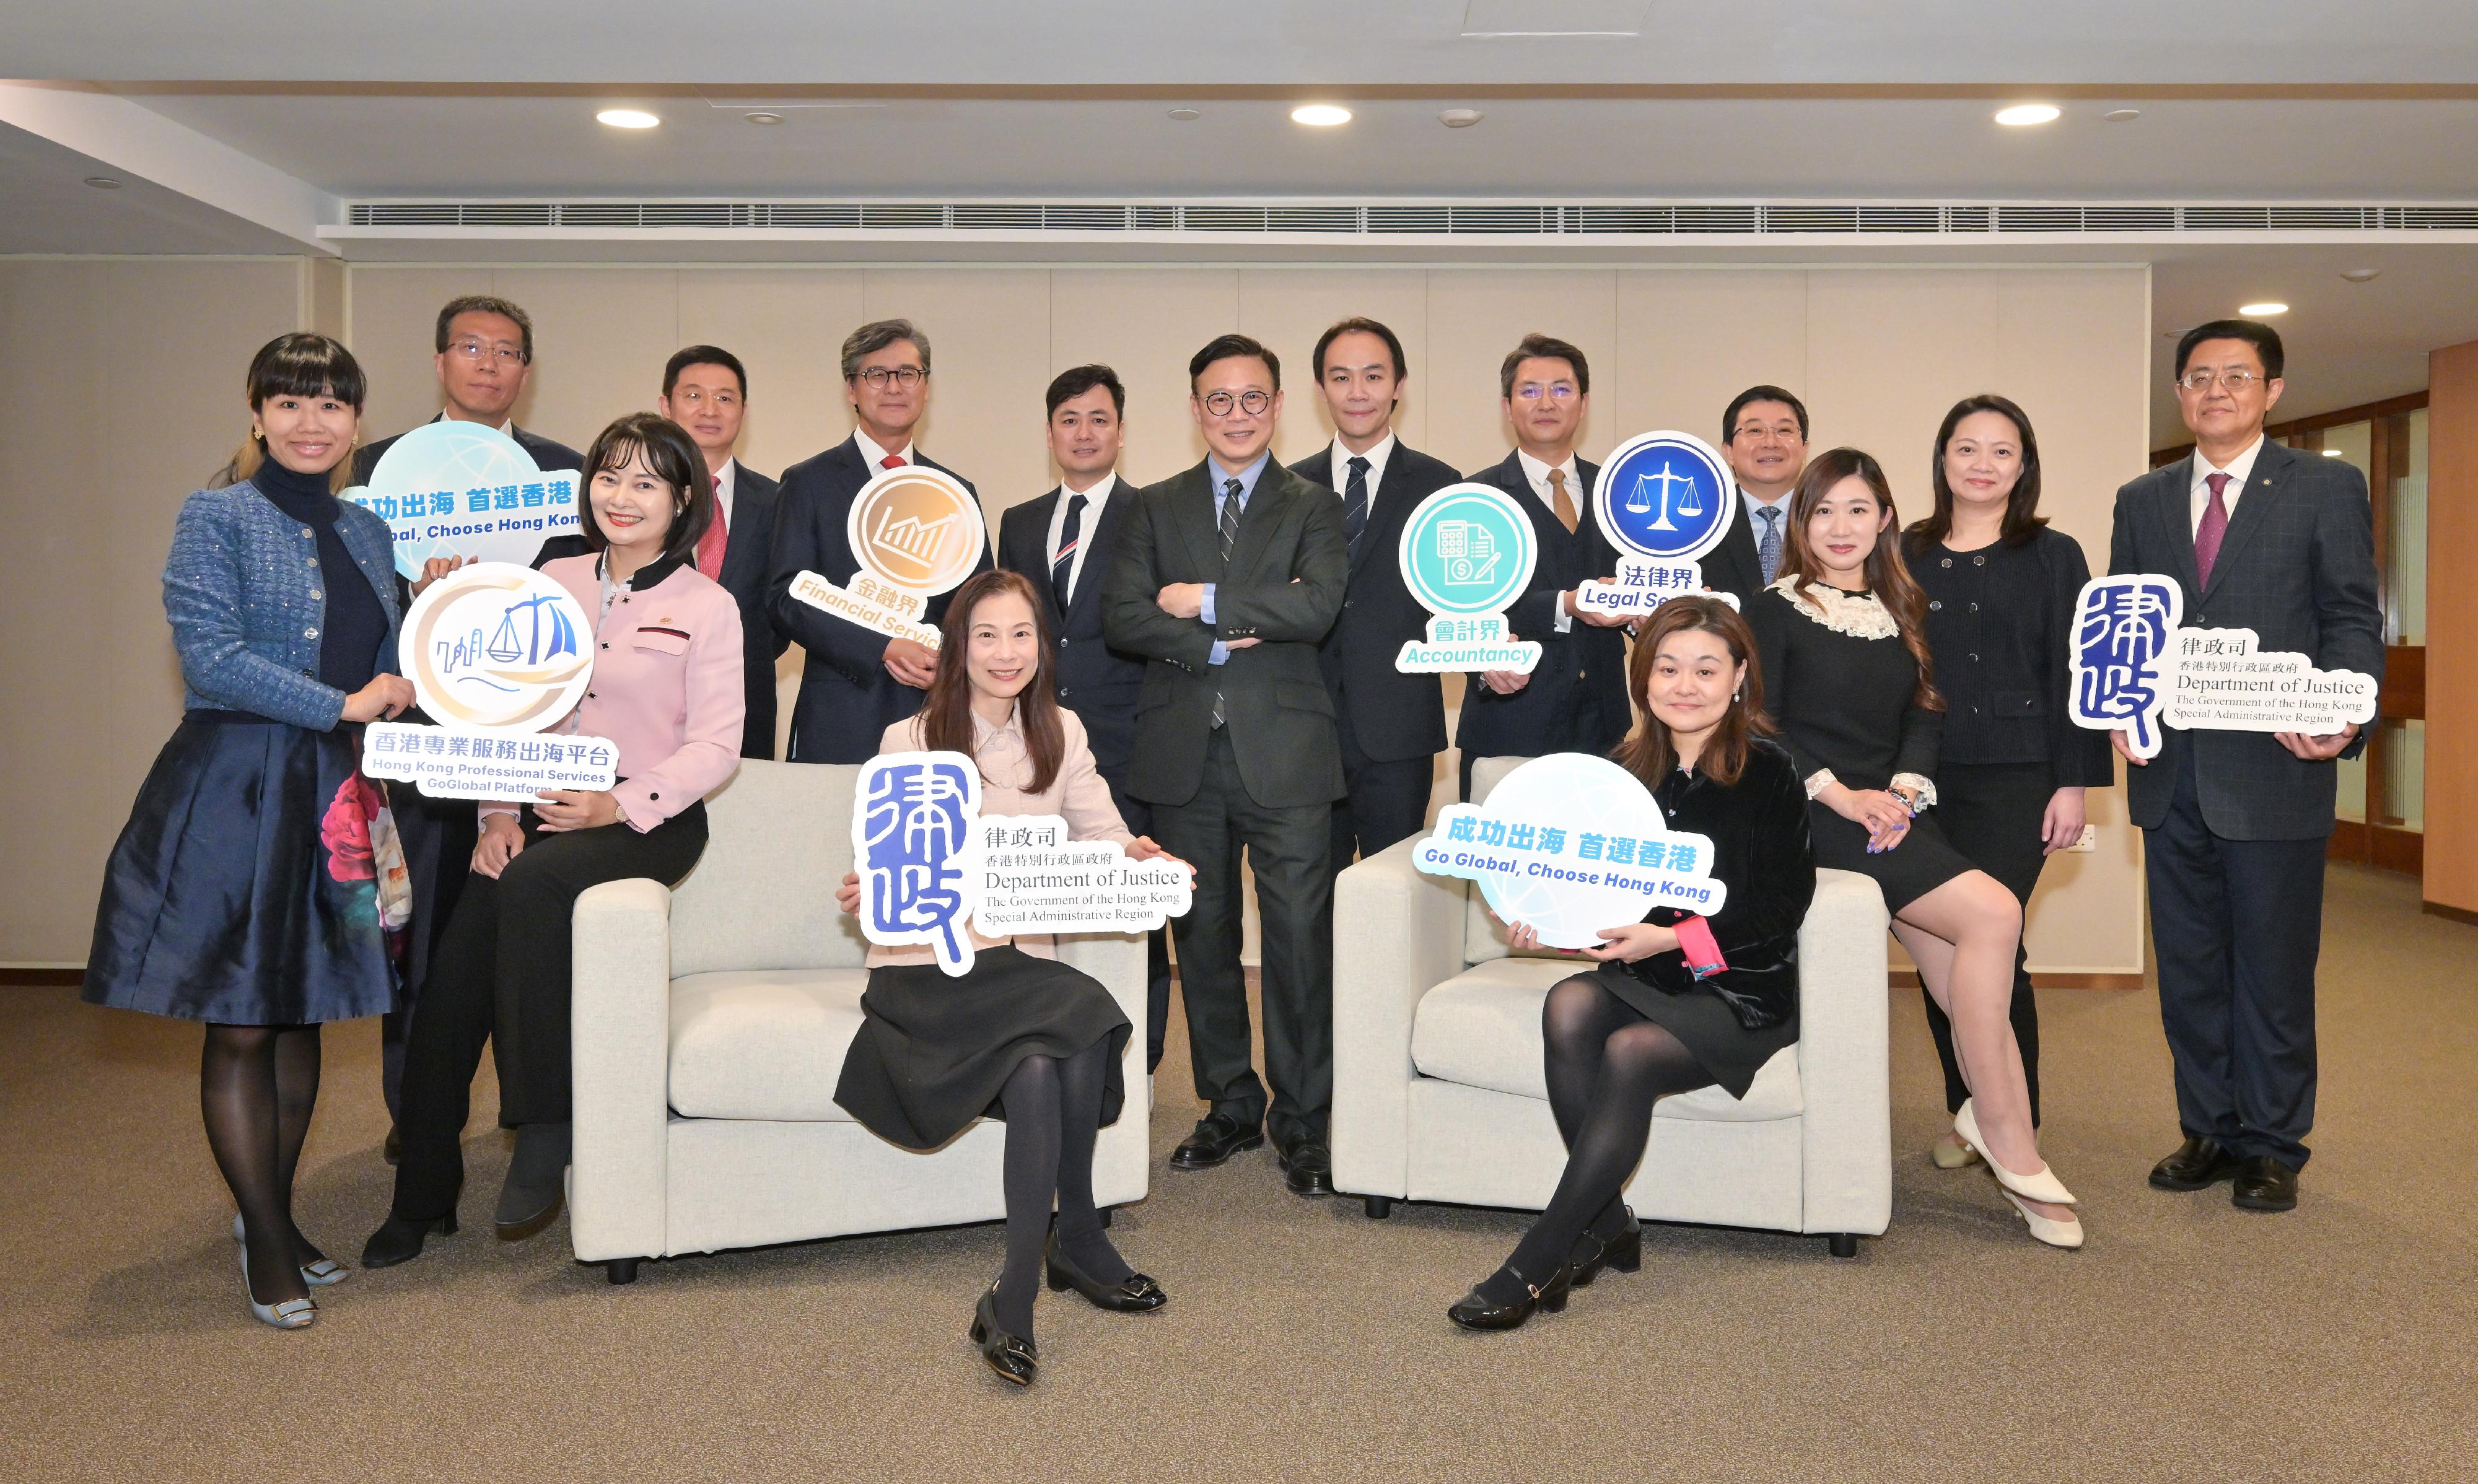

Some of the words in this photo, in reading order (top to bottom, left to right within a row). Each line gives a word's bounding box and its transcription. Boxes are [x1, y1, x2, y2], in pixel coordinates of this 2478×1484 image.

[355, 491, 454, 520] 功出海
[466, 481, 572, 512] 首選香港
[427, 523, 493, 538] Choose
[498, 517, 543, 531] Hong
[548, 514, 580, 526] Kon
[1624, 565, 1692, 589] 法律界
[854, 578, 918, 616] 金融界
[1585, 588, 1639, 609] Legal
[798, 579, 882, 624] Financial
[882, 617, 938, 648] Servic
[1435, 620, 1500, 642] 會計界
[1405, 647, 1533, 665] Accountancy
[2181, 637, 2246, 656] 律政司
[2179, 661, 2299, 674] 香港特別行政區政府
[2177, 675, 2275, 694] Department
[2280, 678, 2301, 692] of
[2303, 679, 2364, 695] Justice
[2176, 695, 2195, 705] The
[2198, 696, 2262, 708] Government
[2265, 698, 2278, 707] of
[2279, 699, 2295, 708] the
[2299, 700, 2329, 712] Hong
[2332, 701, 2363, 713] Kong
[2174, 708, 2210, 720] Special
[2214, 710, 2292, 722] Administrative
[2295, 713, 2334, 725] Region
[375, 732, 610, 766] 香港專業服務出海平台
[372, 759, 411, 772] Hong
[416, 761, 453, 775] Kong
[458, 764, 544, 779] Professional
[548, 770, 606, 783] Services
[427, 778, 491, 792] GoGlobal
[984, 827, 1056, 848] 律政司
[1448, 816, 1567, 855] 成功出海
[1578, 832, 1697, 873] 首選香港
[984, 853, 1113, 867] 香港特別行政區政府
[985, 872, 1090, 893] Department
[1097, 870, 1117, 887] of
[1119, 869, 1180, 886] Justice
[1425, 849, 1450, 864] Go
[1455, 852, 1521, 877] Global,
[1528, 862, 1599, 884] Choose
[1603, 873, 1655, 896] Hong
[1659, 881, 1711, 904] Kong
[985, 896, 1006, 907] The
[1010, 895, 1079, 906] Government
[1082, 894, 1097, 904] of
[1098, 894, 1113, 904] the
[1117, 893, 1148, 907] Hong
[1150, 892, 1180, 905] Kong
[985, 912, 1026, 924] Special
[1029, 910, 1111, 922] Administrative
[1115, 909, 1154, 922] Region
